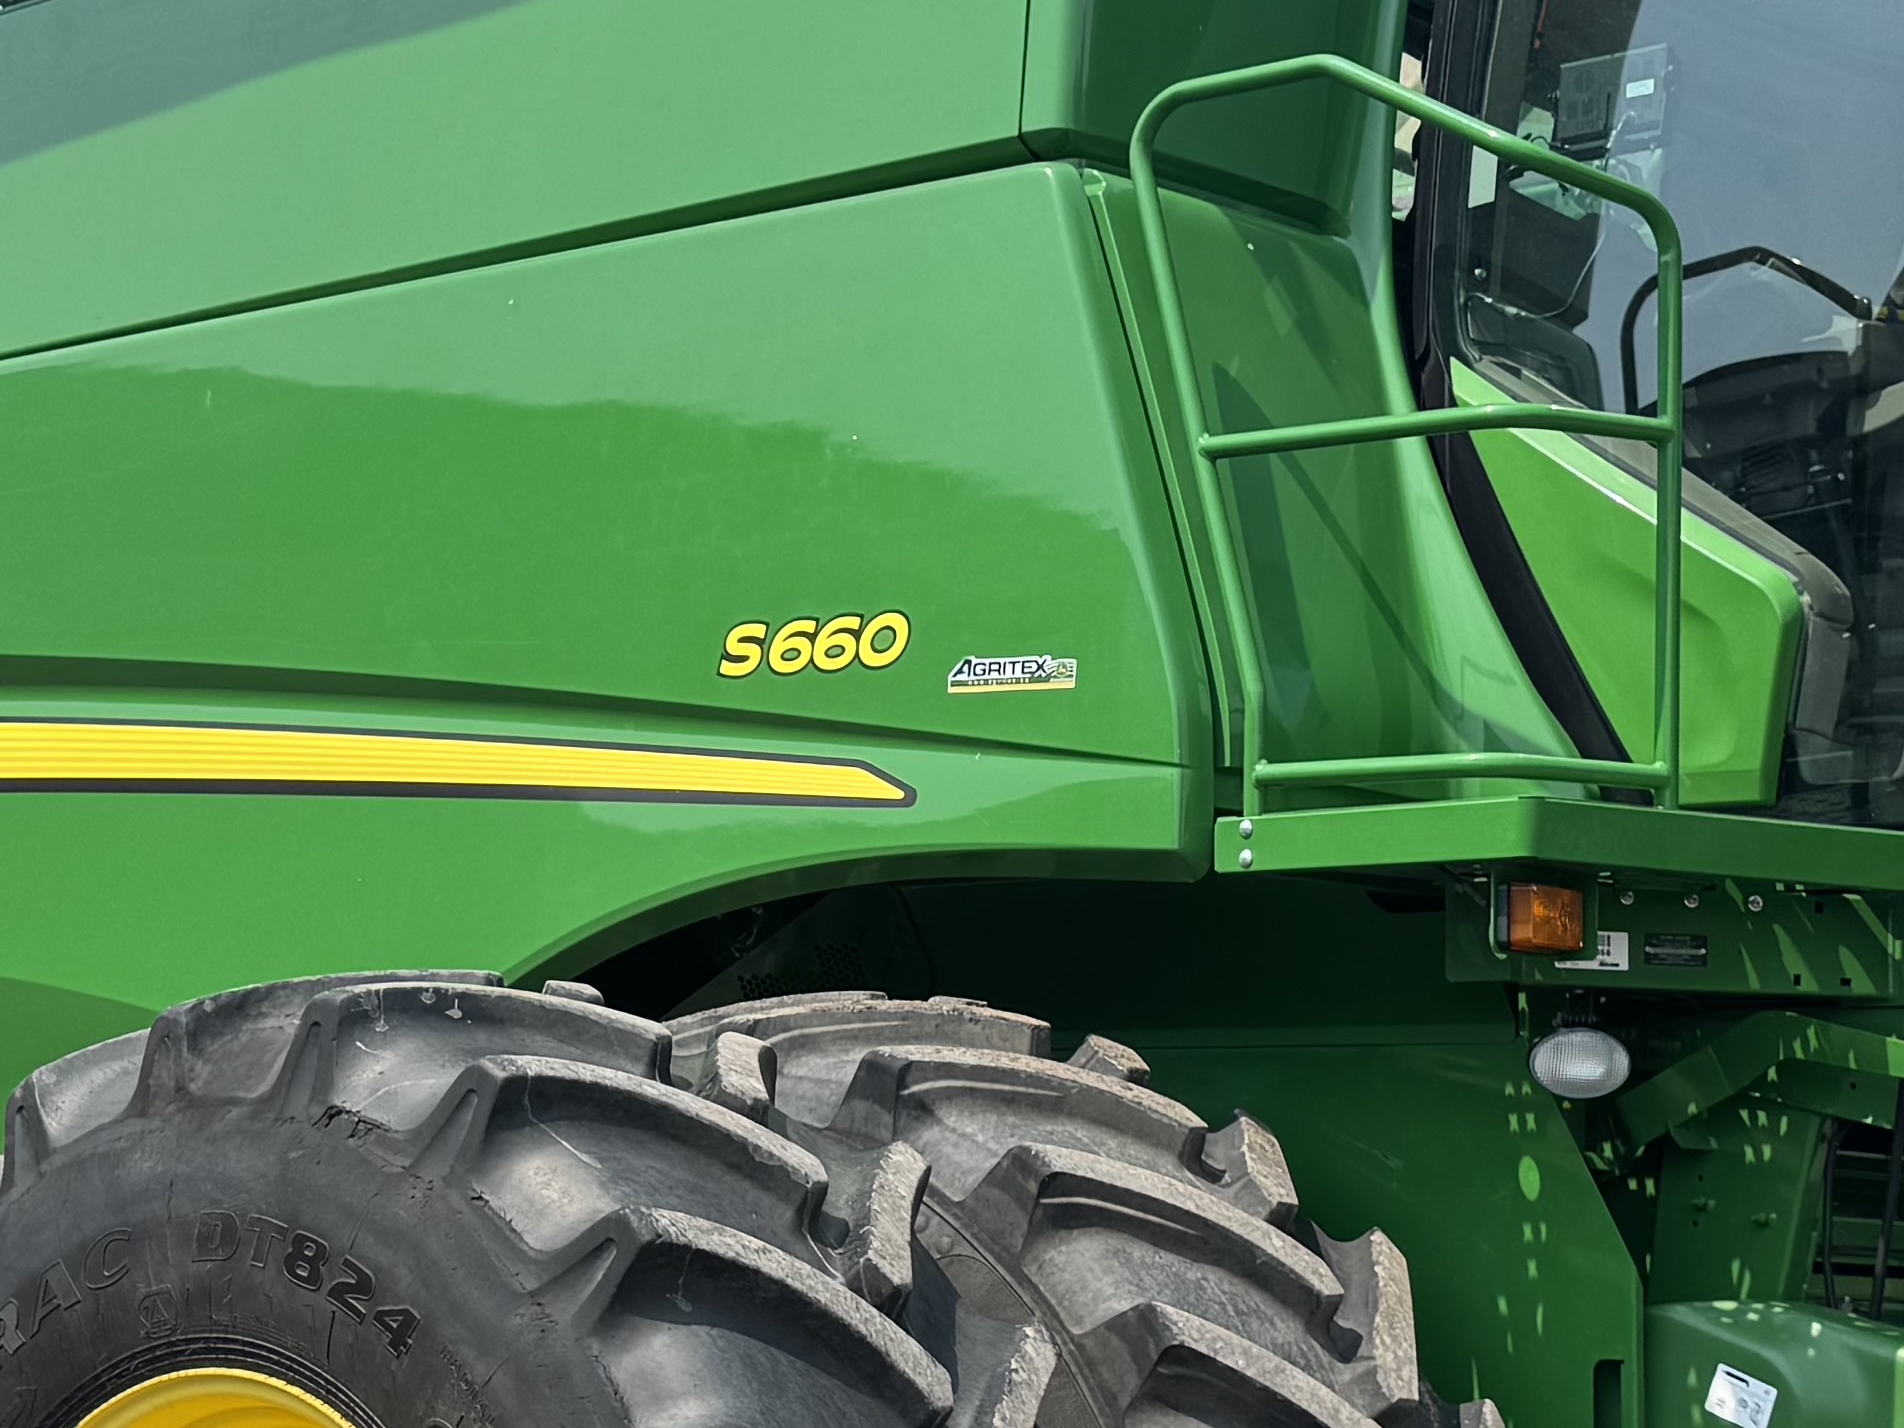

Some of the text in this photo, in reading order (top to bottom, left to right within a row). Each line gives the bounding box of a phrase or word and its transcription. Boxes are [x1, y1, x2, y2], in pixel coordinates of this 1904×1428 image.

[717, 609, 911, 678] S660
[952, 658, 1048, 678] AGRITEX
[191, 1210, 422, 1356] DT824
